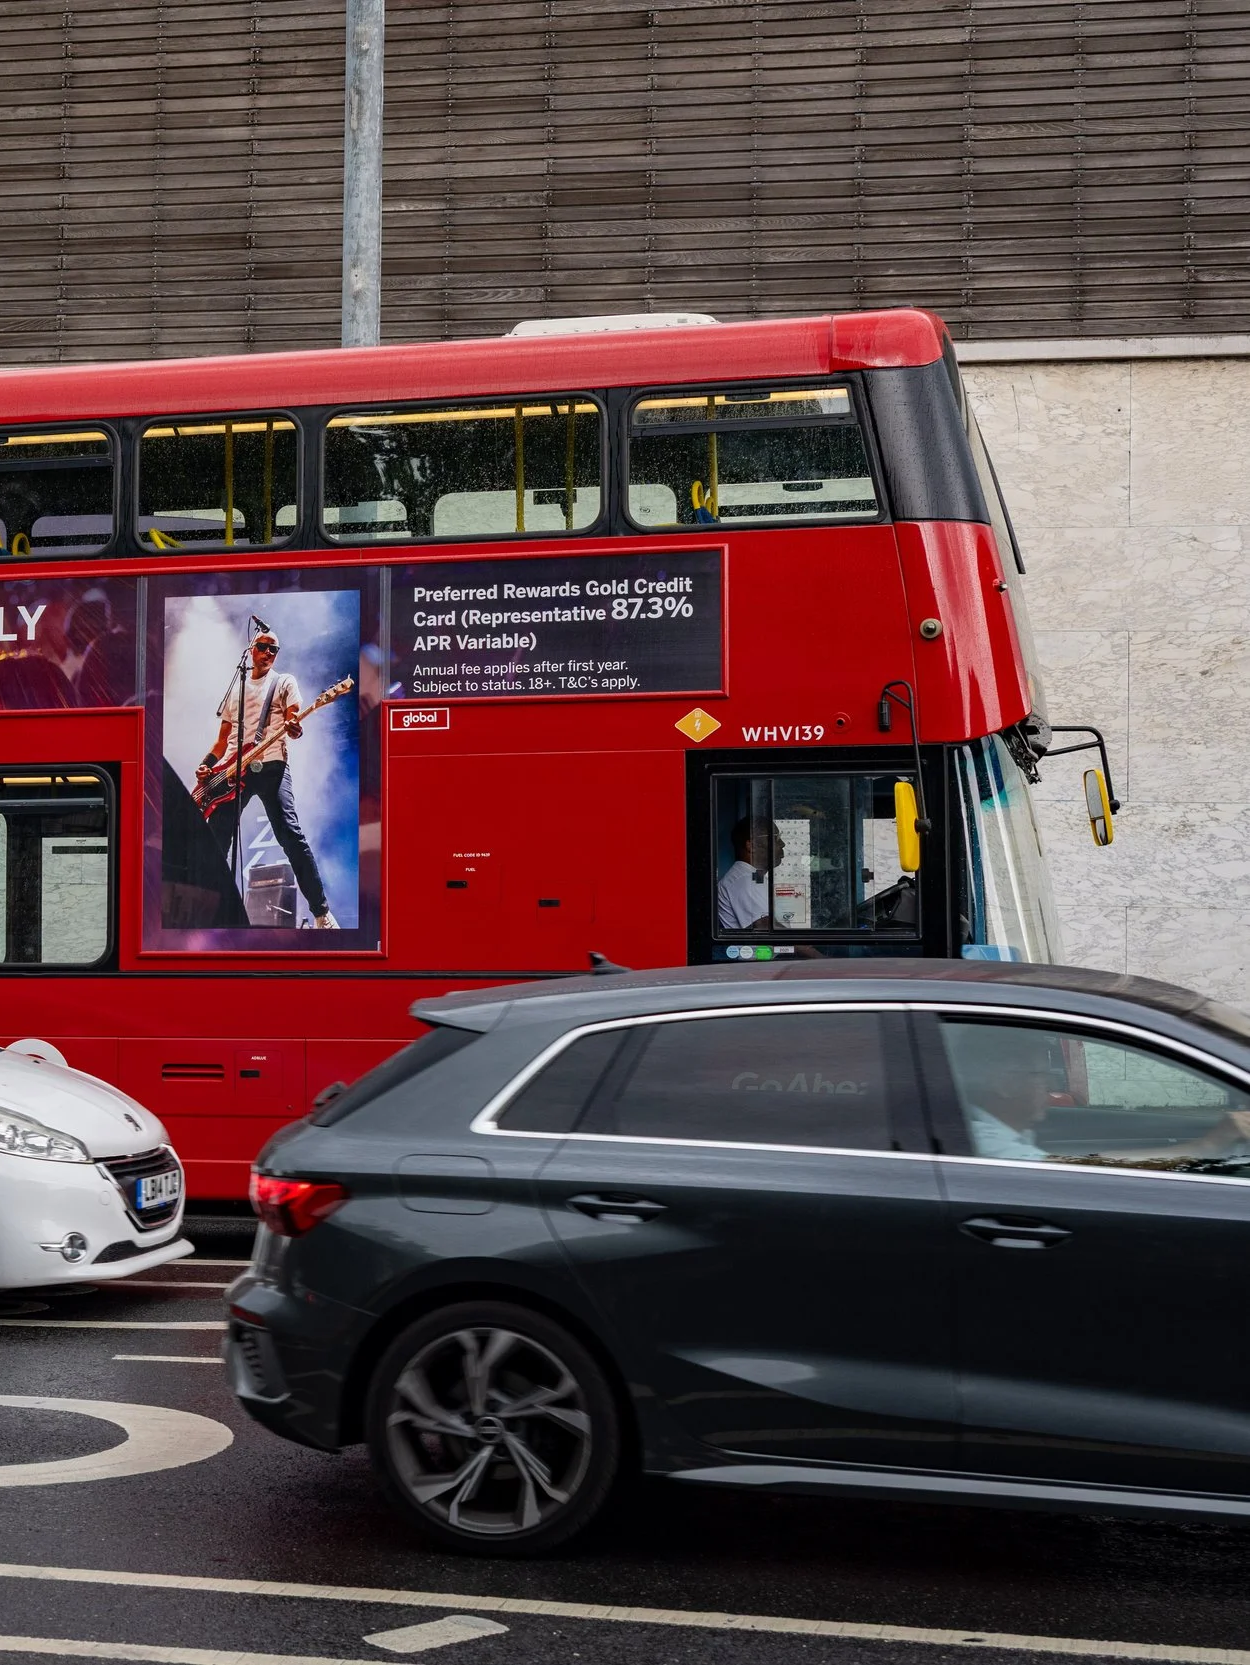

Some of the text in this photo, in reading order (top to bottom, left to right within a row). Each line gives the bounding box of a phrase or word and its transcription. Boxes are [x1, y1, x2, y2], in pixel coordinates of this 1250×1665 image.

[413, 577, 693, 602] Preferred Rewards Gold Credit
[413, 596, 694, 628] Card (Representative 87.3%
[413, 632, 537, 651] APR Variable)
[413, 660, 629, 676] Annual fee applies after first year.
[413, 675, 641, 694] Subject to status. 18+. T&C's apply.
[402, 711, 438, 728] global
[741, 725, 825, 742] WHV139
